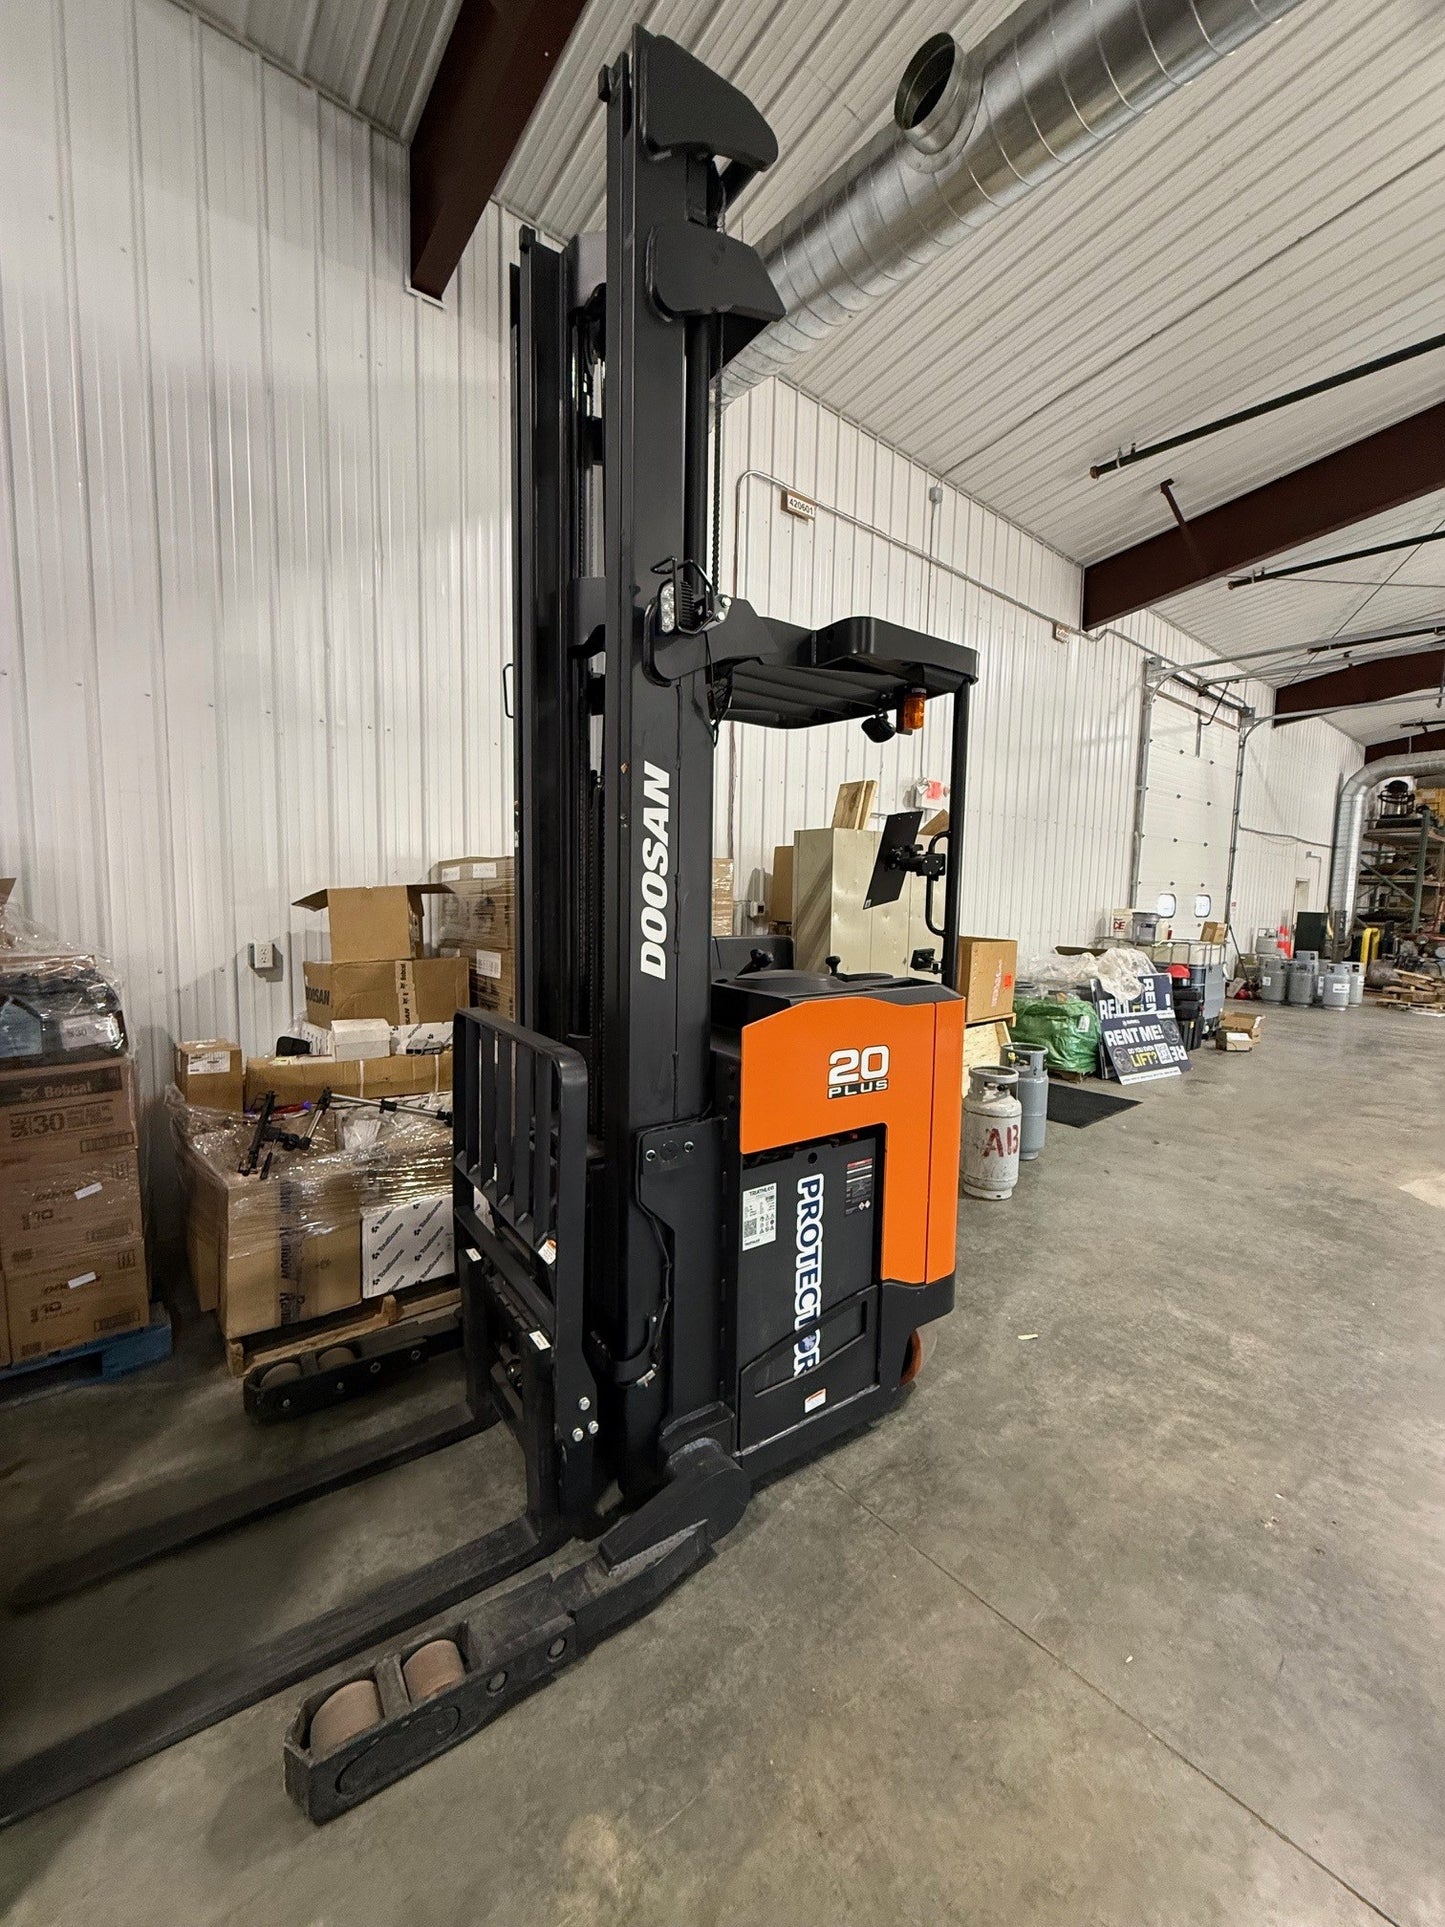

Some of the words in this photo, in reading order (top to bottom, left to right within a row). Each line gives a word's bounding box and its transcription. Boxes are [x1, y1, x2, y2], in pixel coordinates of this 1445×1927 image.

[640, 760, 670, 980] DOOSAN
[1104, 1027, 1140, 1047] RENT
[1140, 1024, 1165, 1042] ME!
[828, 1045, 890, 1086] 20
[1131, 1052, 1159, 1067] LIFT?
[44, 1080, 92, 1098] Bobcat
[828, 1080, 888, 1099] PLUS
[33, 1112, 65, 1135] 30
[377, 1223, 404, 1252] TotalSource
[420, 1226, 445, 1254] TotalSource
[378, 1249, 405, 1278] TotalSource
[794, 1173, 824, 1378] PROTECTOR
